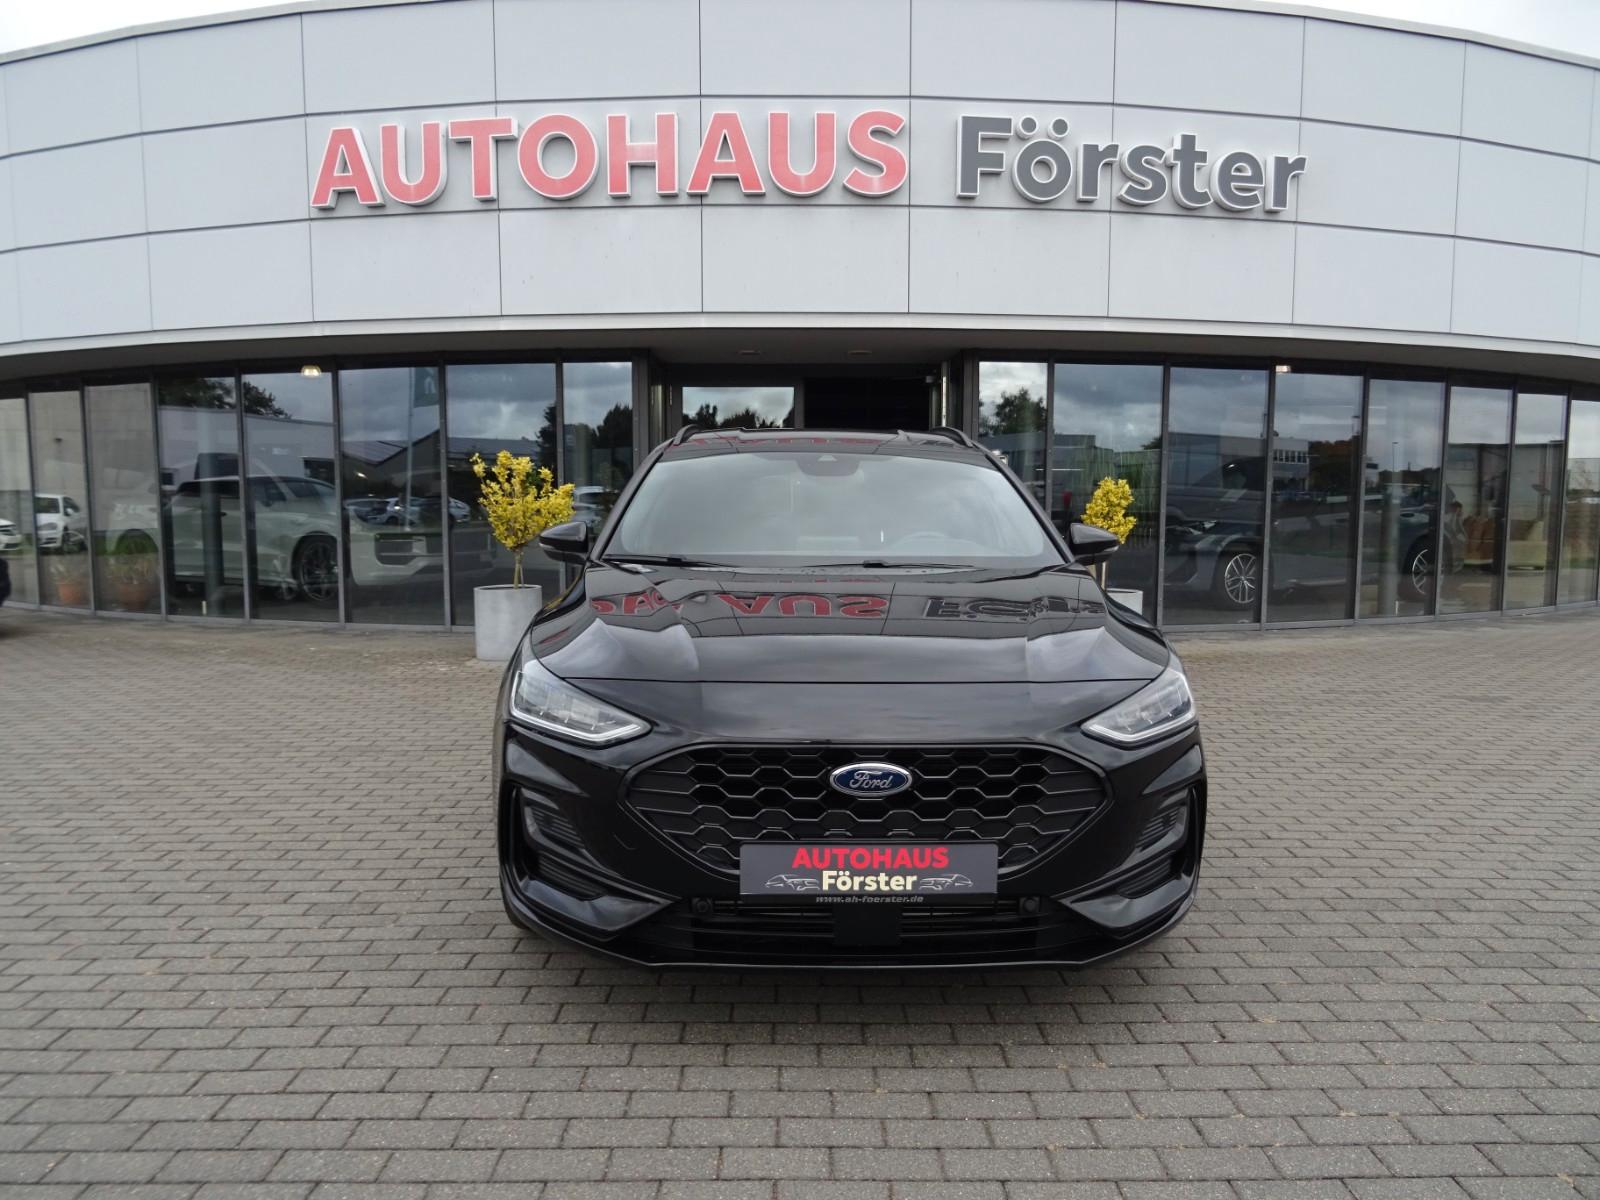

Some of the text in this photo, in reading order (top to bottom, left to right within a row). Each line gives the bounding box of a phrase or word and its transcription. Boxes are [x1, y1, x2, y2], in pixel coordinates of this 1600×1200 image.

[310, 109, 1309, 213] AUTOHAUS Förster
[849, 770, 893, 789] Ford
[791, 847, 949, 870] AUTOHAUS
[822, 870, 917, 891] Förster
[815, 895, 925, 904] www.ah-foerster.de
